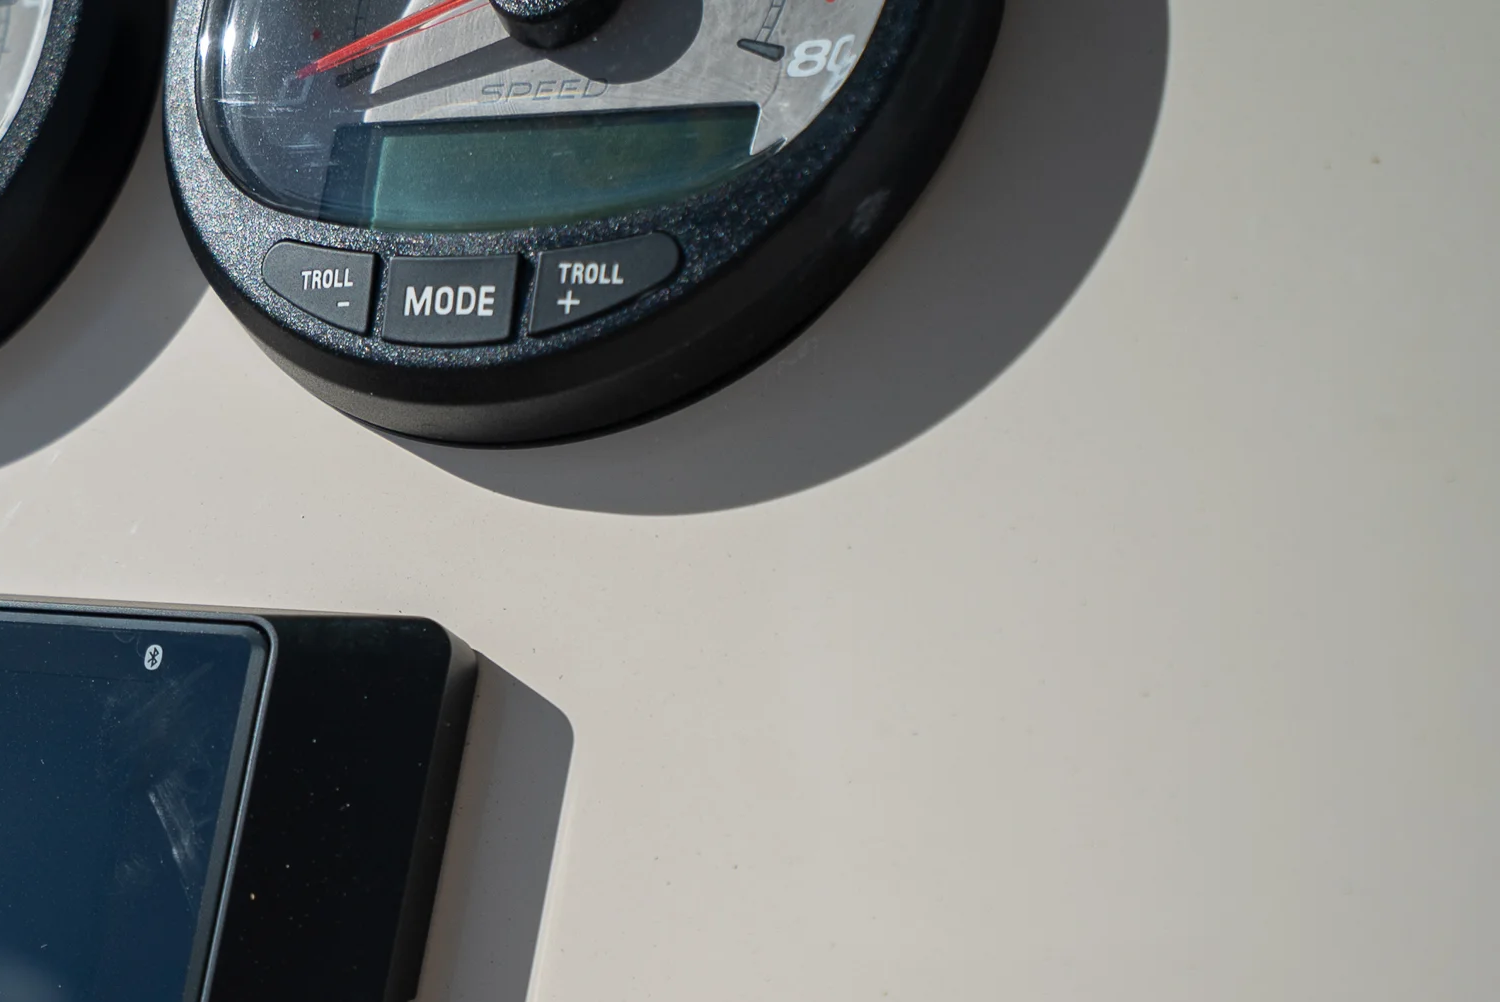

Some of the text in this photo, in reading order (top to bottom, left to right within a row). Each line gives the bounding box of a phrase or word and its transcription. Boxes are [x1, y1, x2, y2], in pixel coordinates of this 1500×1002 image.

[477, 78, 609, 104] SPEED
[301, 268, 354, 290] TROLL
[558, 263, 624, 285] TROLL
[404, 286, 496, 316] MODE
